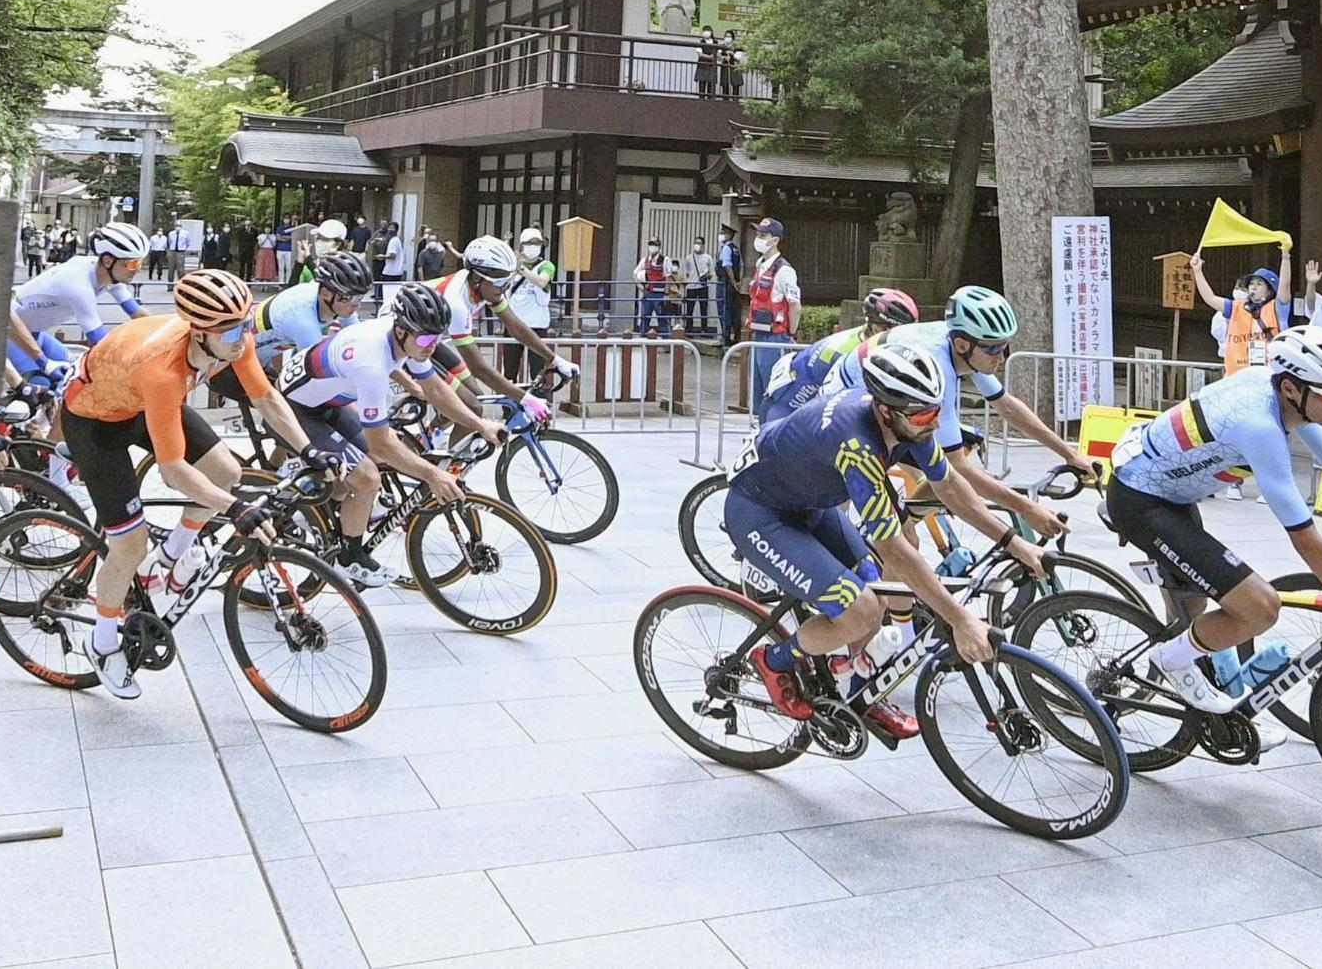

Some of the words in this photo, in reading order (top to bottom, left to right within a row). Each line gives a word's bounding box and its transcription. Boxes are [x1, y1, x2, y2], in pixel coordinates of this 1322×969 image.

[1274, 355, 1308, 376] HJC
[1173, 457, 1216, 479] BELGIUM
[367, 492, 424, 550] SPECIALIZED
[166, 550, 230, 624] KOGA
[745, 565, 769, 591] 105
[746, 530, 814, 595] ROMANIA
[1158, 544, 1212, 593] BELGIUM
[468, 617, 525, 630] roval
[642, 608, 673, 691] CORIMA
[862, 624, 941, 706] LOOK
[1249, 641, 1322, 712] BMC
[1049, 773, 1114, 832] CORIMA
